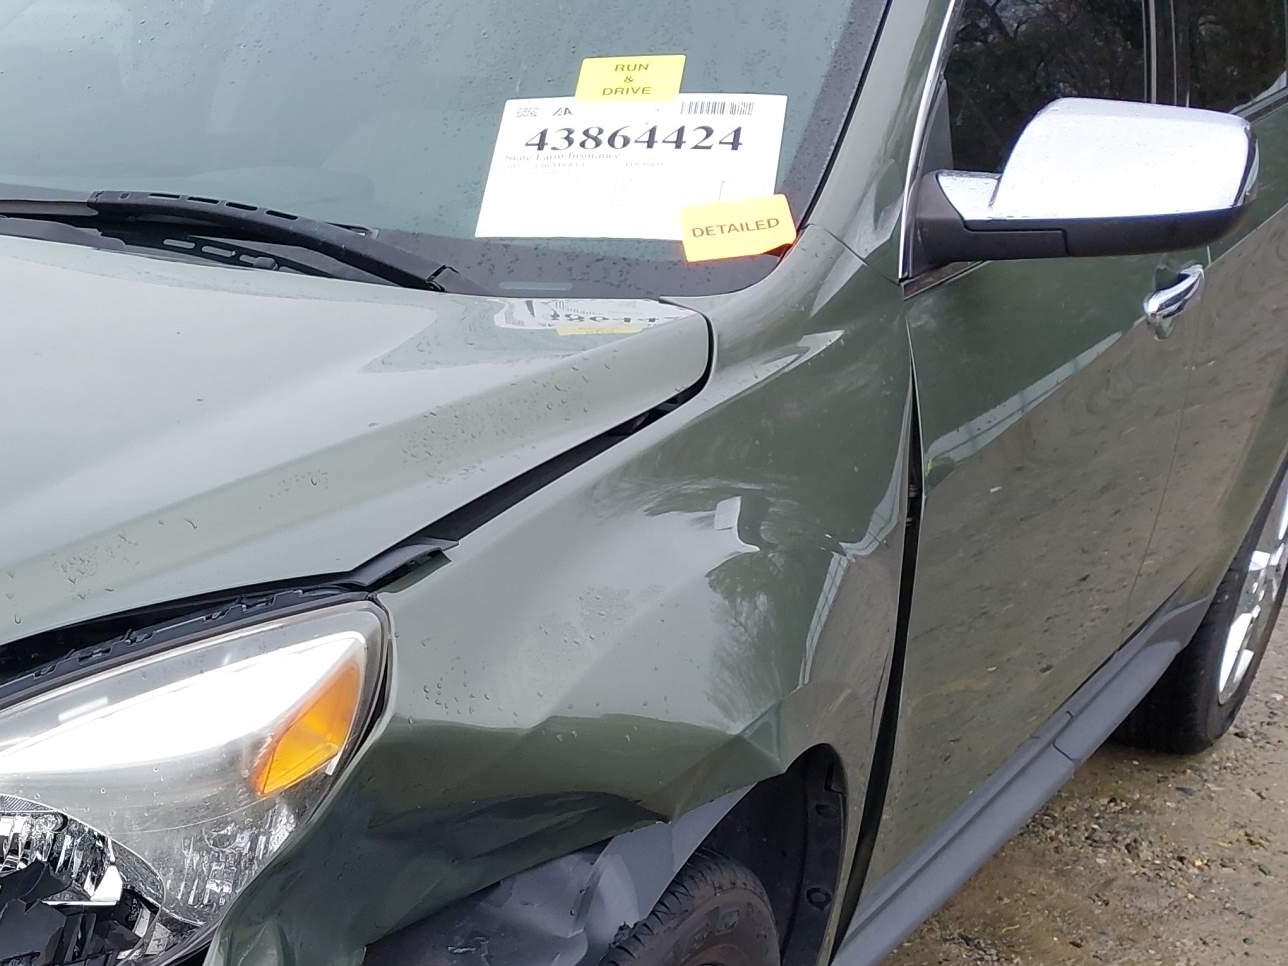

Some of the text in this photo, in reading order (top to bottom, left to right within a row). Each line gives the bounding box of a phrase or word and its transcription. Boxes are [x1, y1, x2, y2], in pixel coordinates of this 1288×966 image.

[614, 63, 649, 72] RUN
[623, 75, 634, 83] &
[602, 86, 652, 96] DRIVE
[524, 124, 744, 152] 43864424
[691, 217, 780, 238] DETAILED
